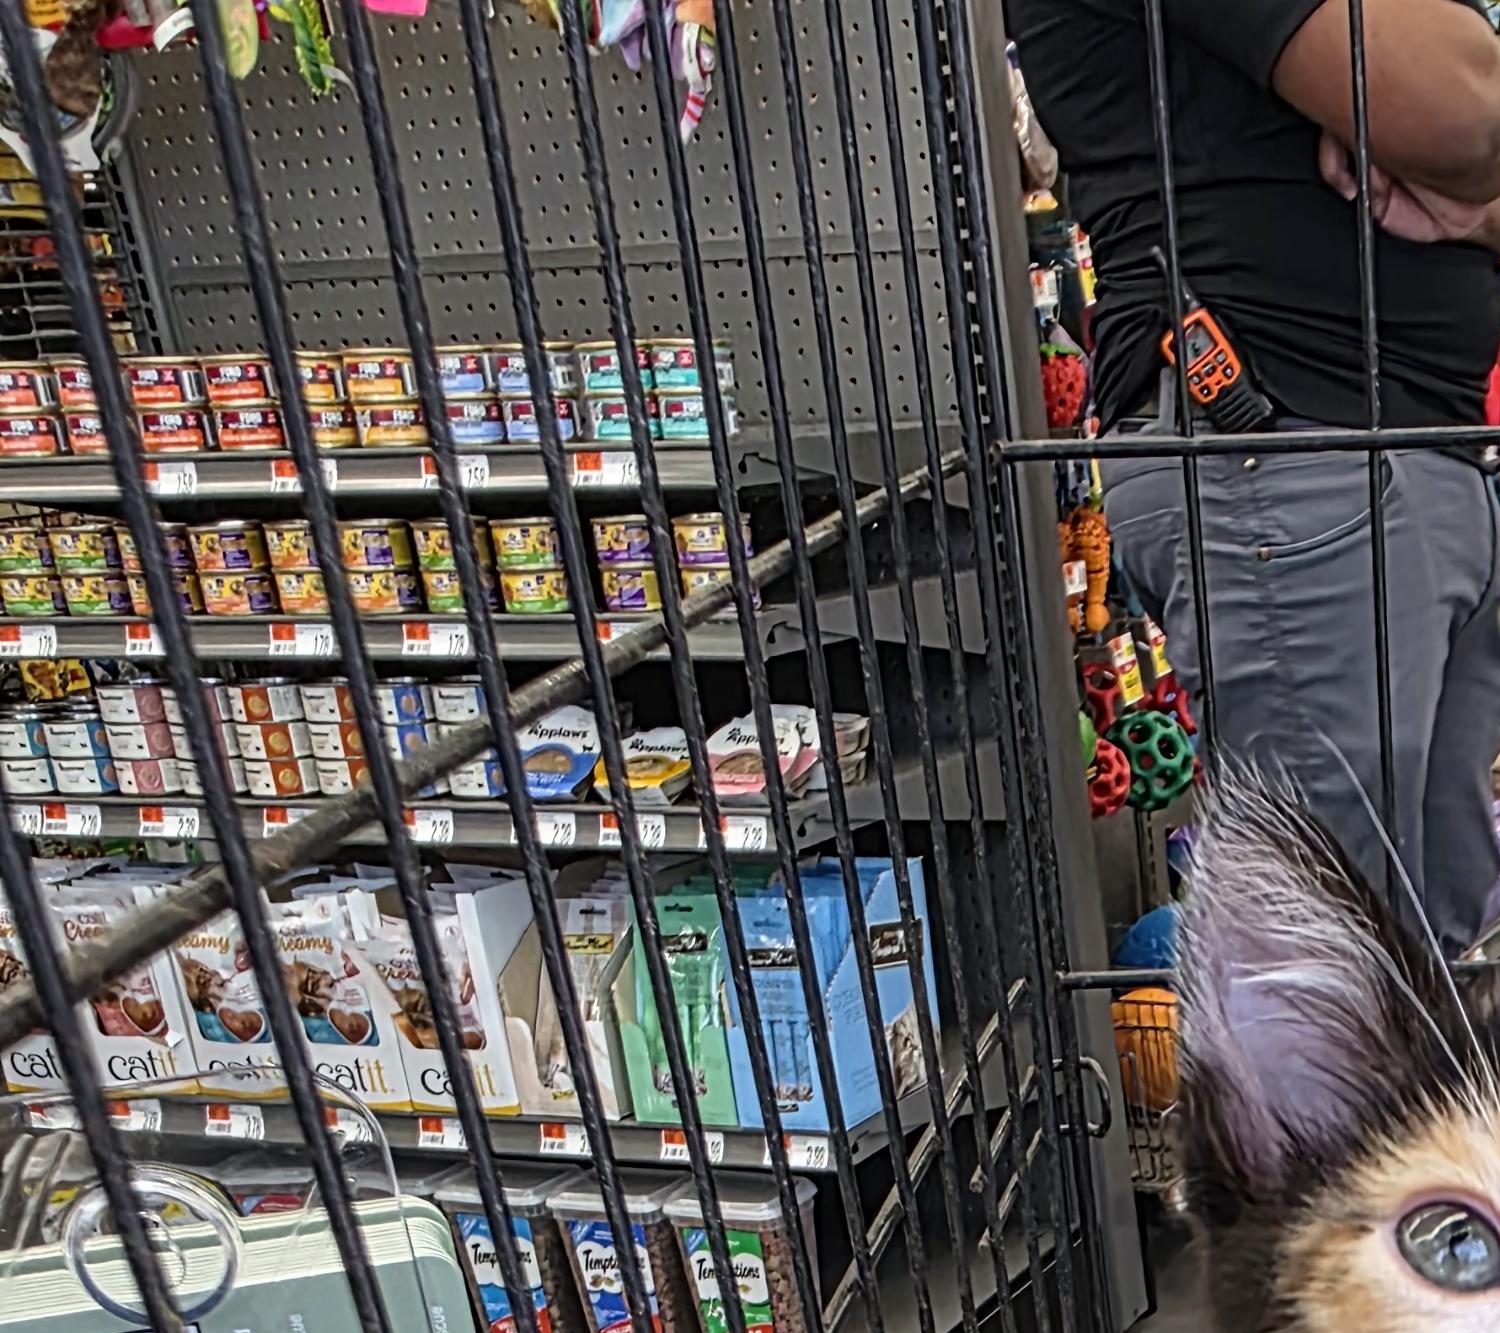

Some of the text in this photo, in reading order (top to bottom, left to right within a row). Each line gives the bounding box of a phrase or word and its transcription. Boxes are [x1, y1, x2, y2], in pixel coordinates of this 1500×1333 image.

[528, 722, 591, 739] Applaws
[10, 1048, 63, 1079] cat
[108, 1051, 177, 1082] catit
[421, 1063, 496, 1097] cait
[696, 1258, 760, 1280] Temtions
